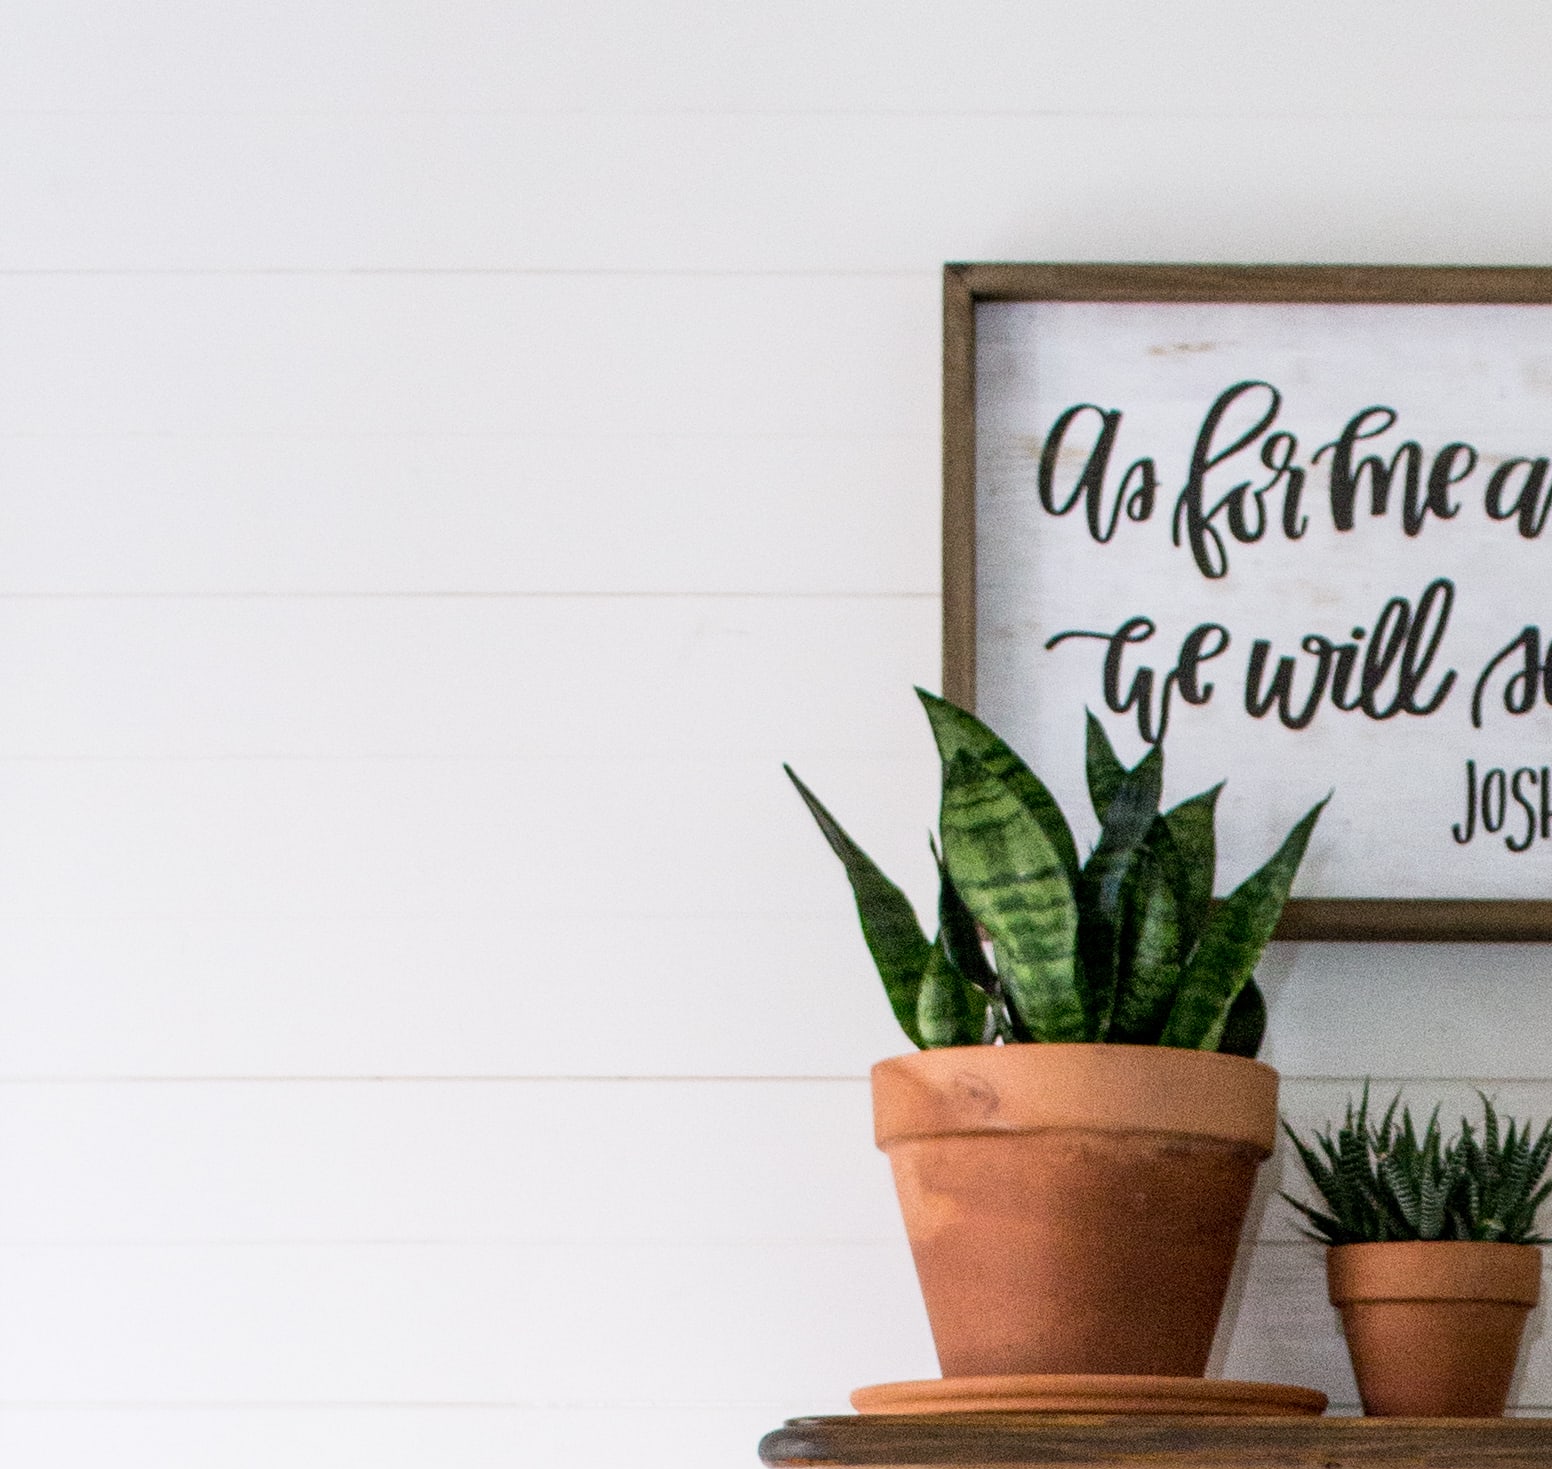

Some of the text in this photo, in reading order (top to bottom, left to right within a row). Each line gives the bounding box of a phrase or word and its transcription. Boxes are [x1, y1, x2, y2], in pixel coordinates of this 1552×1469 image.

[1037, 403, 1158, 544] As
[1172, 381, 1308, 579] for
[1312, 405, 1480, 537] me
[1245, 578, 1458, 730] will
